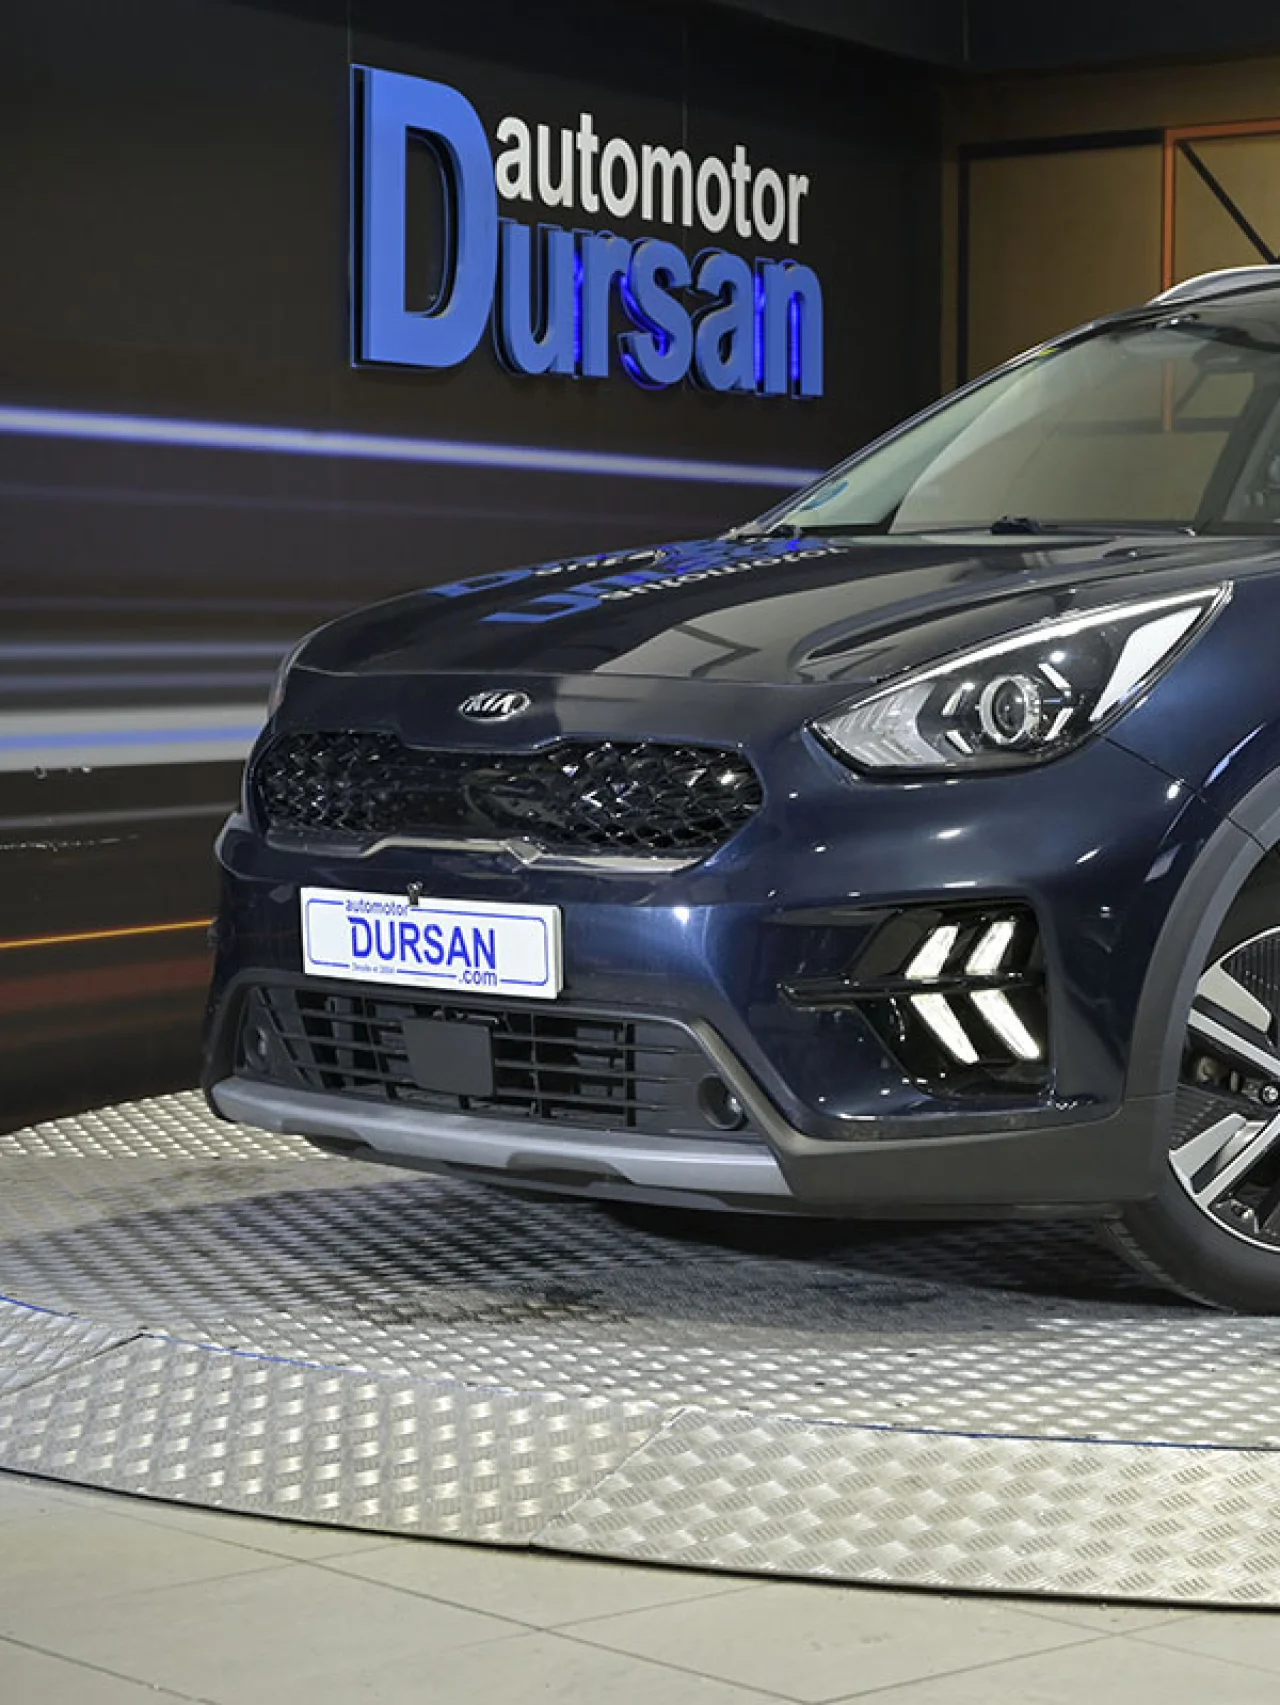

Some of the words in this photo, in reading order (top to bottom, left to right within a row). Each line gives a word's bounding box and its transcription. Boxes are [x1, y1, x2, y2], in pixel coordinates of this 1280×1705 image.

[495, 112, 810, 245] automotor
[350, 63, 825, 399] Dursan
[345, 899, 409, 917] automotor
[347, 915, 496, 970] DURSAN
[459, 970, 497, 986] .com
